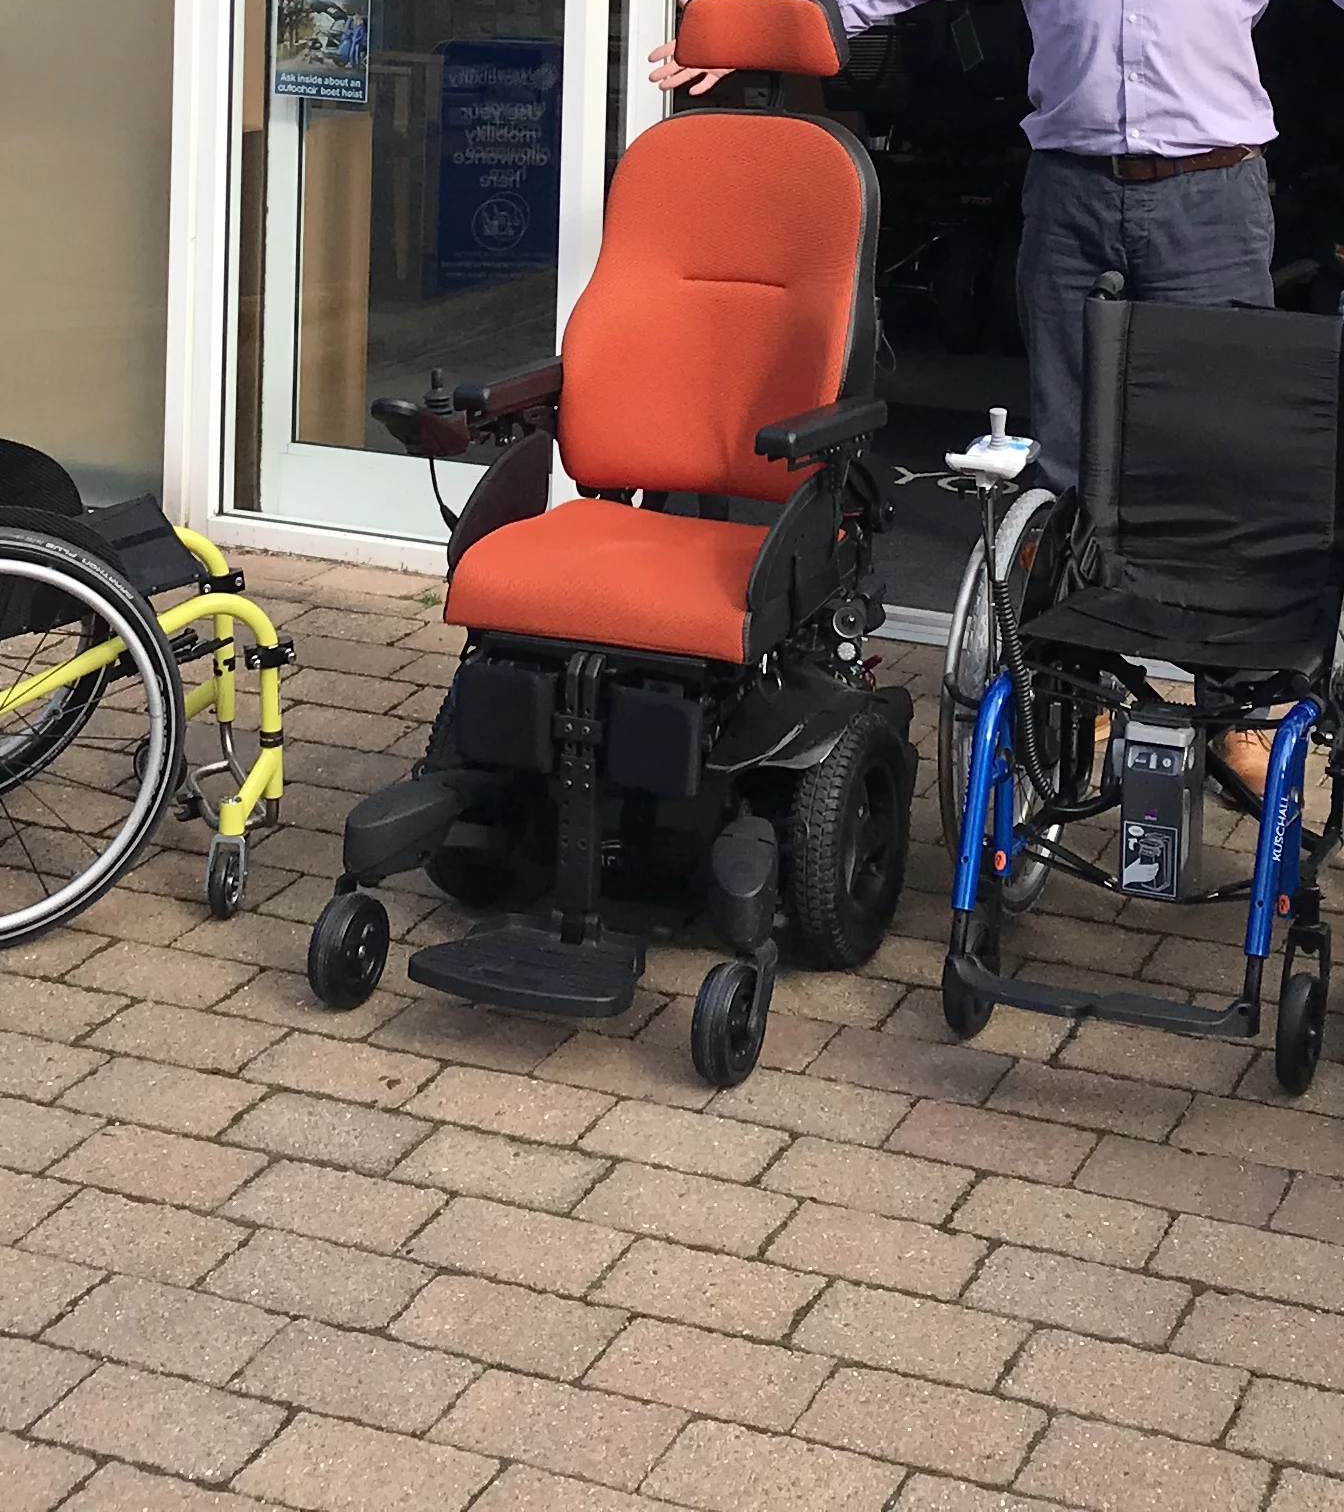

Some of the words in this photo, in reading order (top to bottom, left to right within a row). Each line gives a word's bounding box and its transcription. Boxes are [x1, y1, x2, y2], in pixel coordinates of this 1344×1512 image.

[280, 72, 296, 82] Ask
[297, 73, 323, 85] inside
[324, 75, 349, 86] about
[350, 79, 361, 87] an
